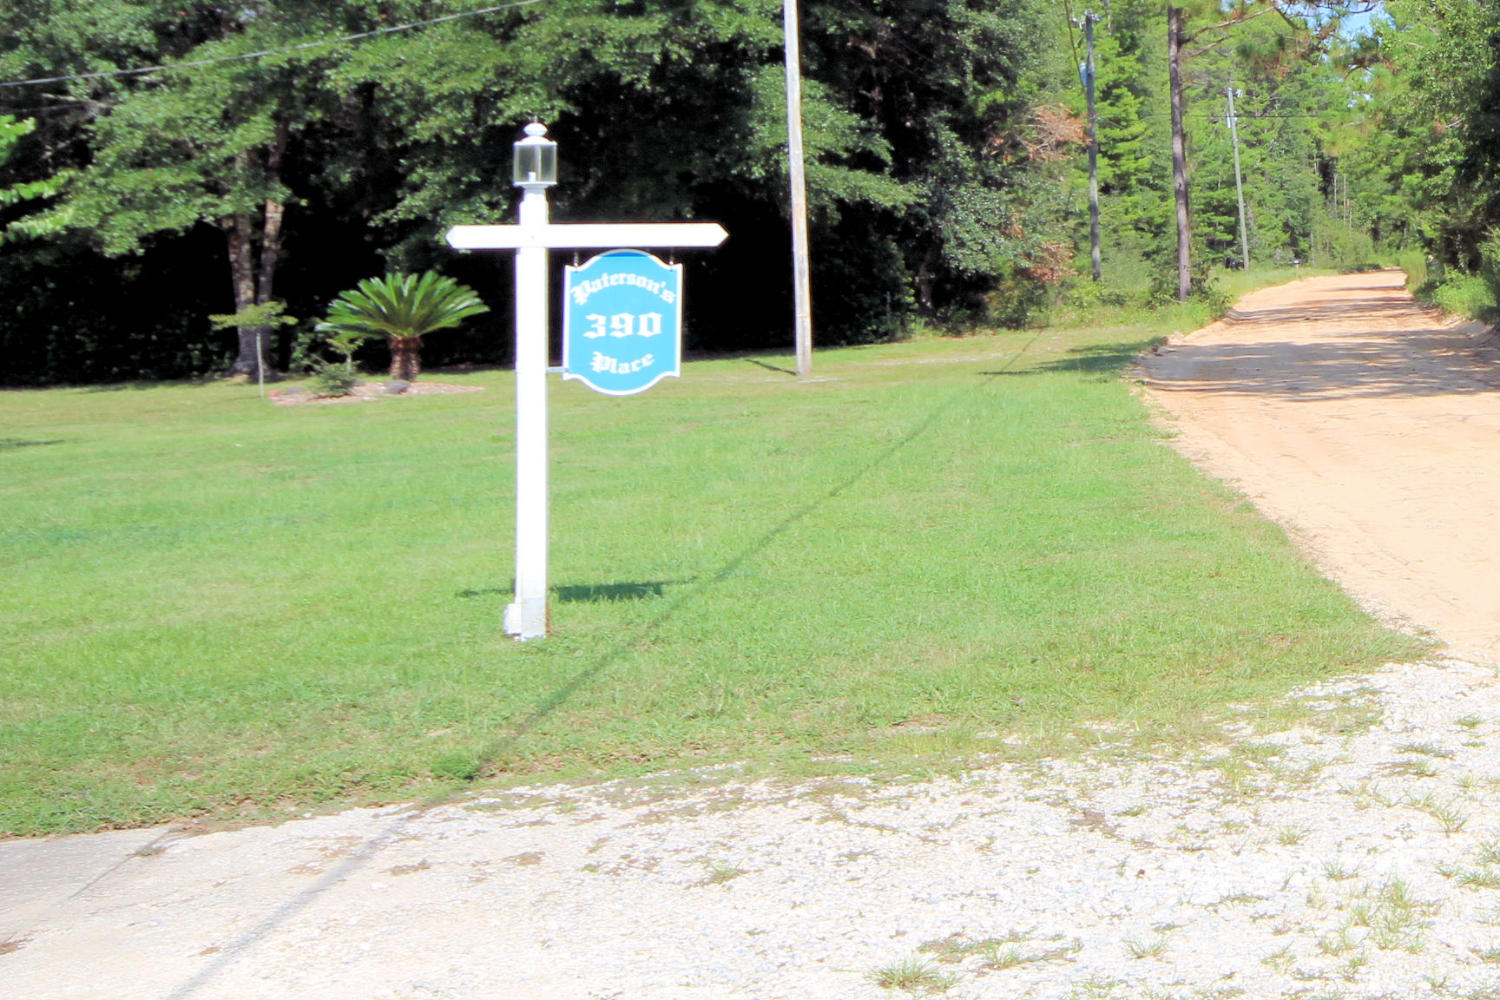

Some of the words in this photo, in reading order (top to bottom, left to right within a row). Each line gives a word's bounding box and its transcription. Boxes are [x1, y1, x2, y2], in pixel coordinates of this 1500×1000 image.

[570, 272, 676, 306] Paterson's
[583, 312, 662, 339] 390
[591, 351, 654, 374] Place
